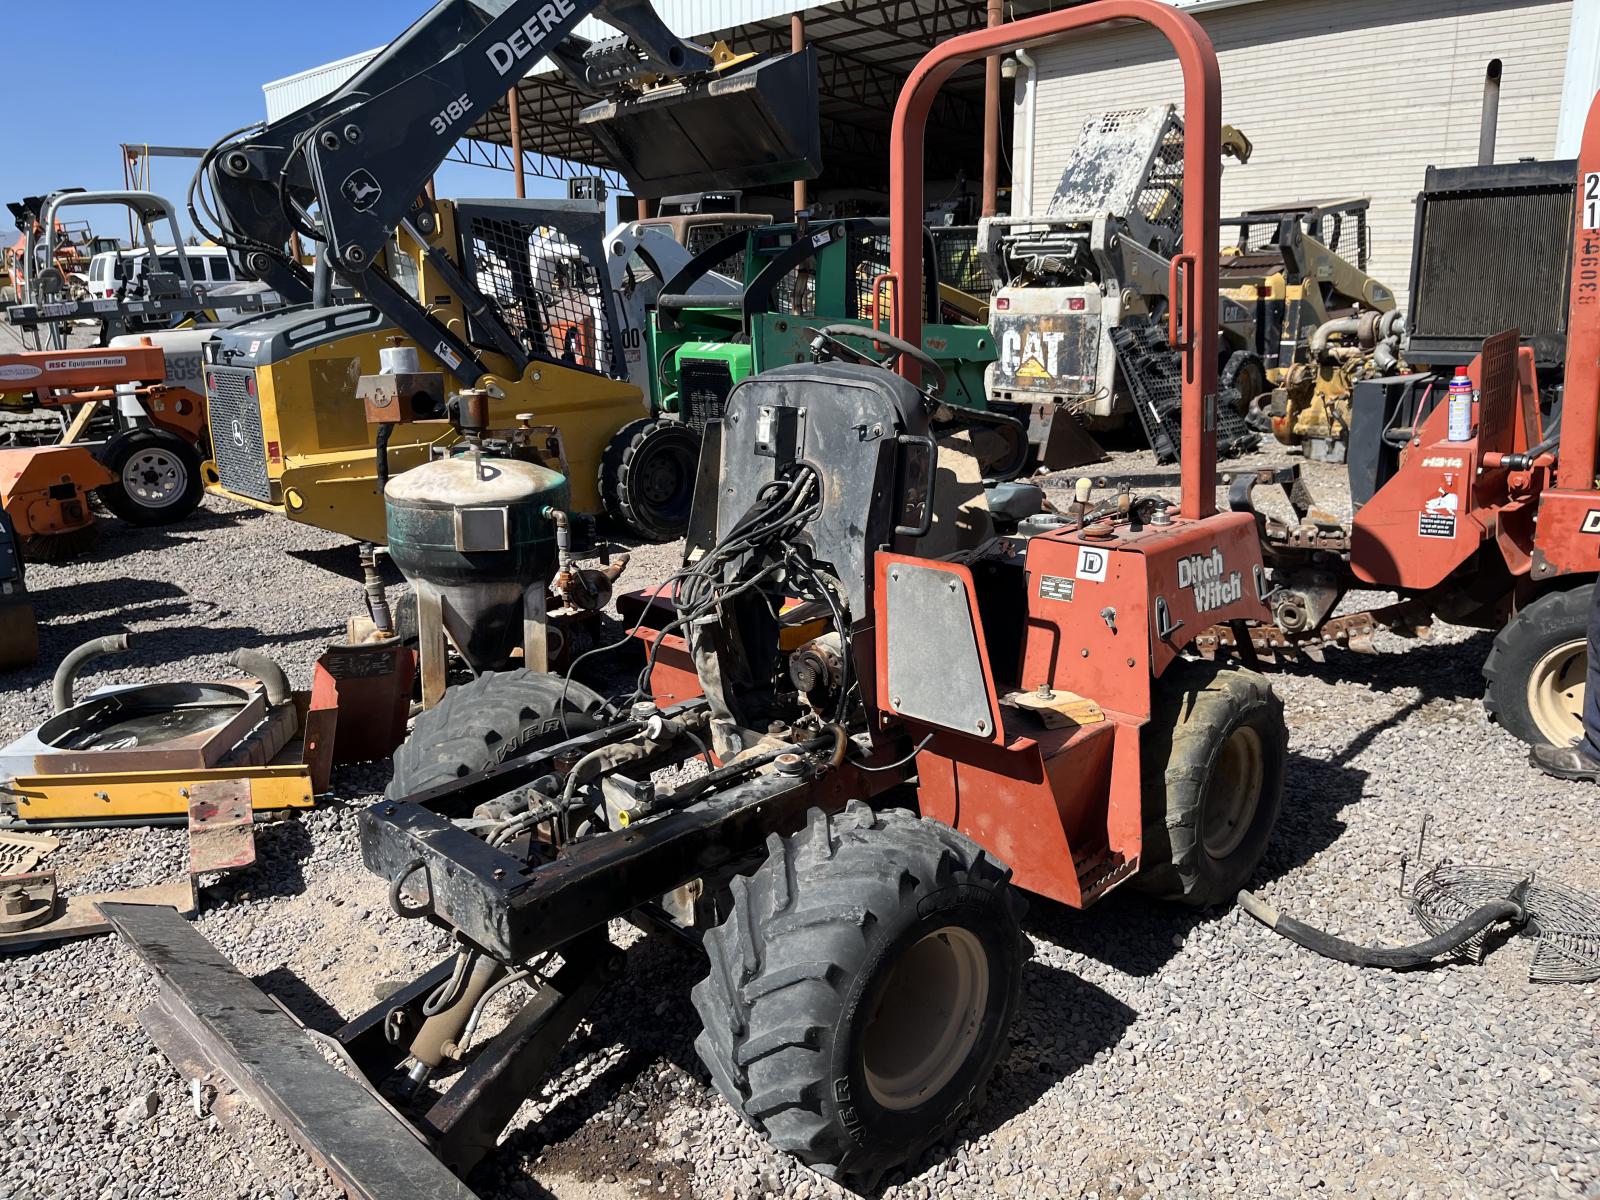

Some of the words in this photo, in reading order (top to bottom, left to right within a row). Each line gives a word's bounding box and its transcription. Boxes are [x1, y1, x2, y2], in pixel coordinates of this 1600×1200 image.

[485, 0, 577, 77] DEERE
[430, 93, 474, 136] 318E
[1225, 306, 1239, 321] CAT
[49, 361, 67, 369] RSC
[68, 359, 102, 368] Equipment
[103, 357, 123, 365] Rental
[1002, 330, 1065, 379] CAT
[1177, 547, 1224, 590] Ditch
[1194, 572, 1241, 613] Witch
